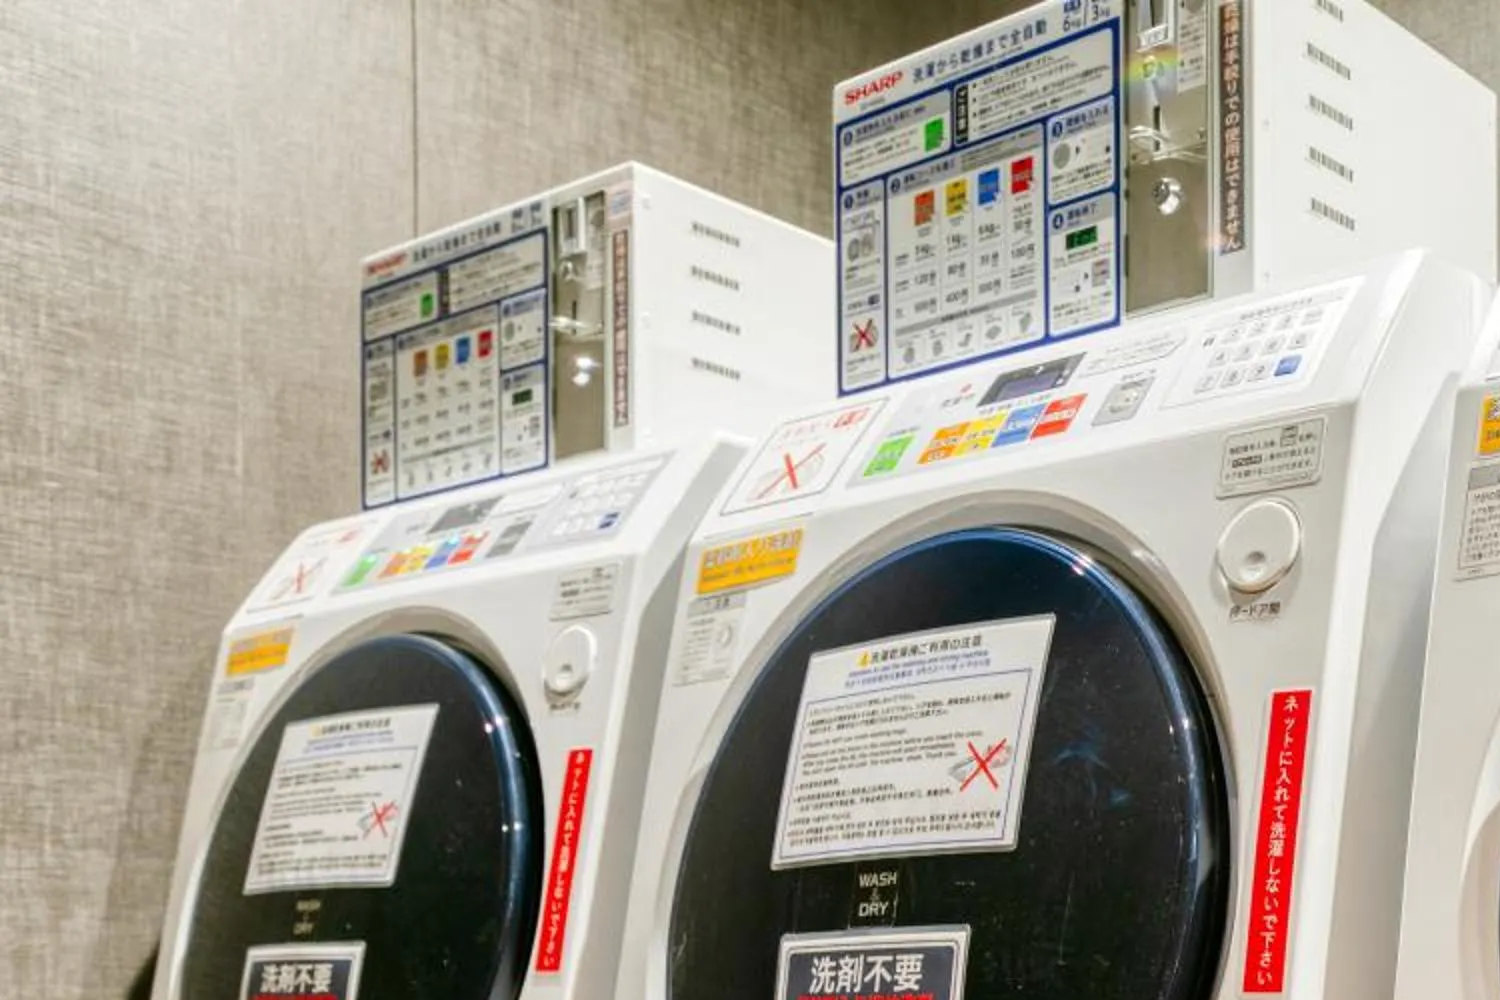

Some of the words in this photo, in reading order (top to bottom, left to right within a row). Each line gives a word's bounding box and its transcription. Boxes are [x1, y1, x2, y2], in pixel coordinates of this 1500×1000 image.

[844, 71, 903, 105] SHARP
[1256, 696, 1298, 985] ネットに入れて洗濯しないで下さい
[859, 872, 897, 888] WASH
[858, 902, 889, 917] DRY
[809, 954, 924, 993] 洗剤不要
